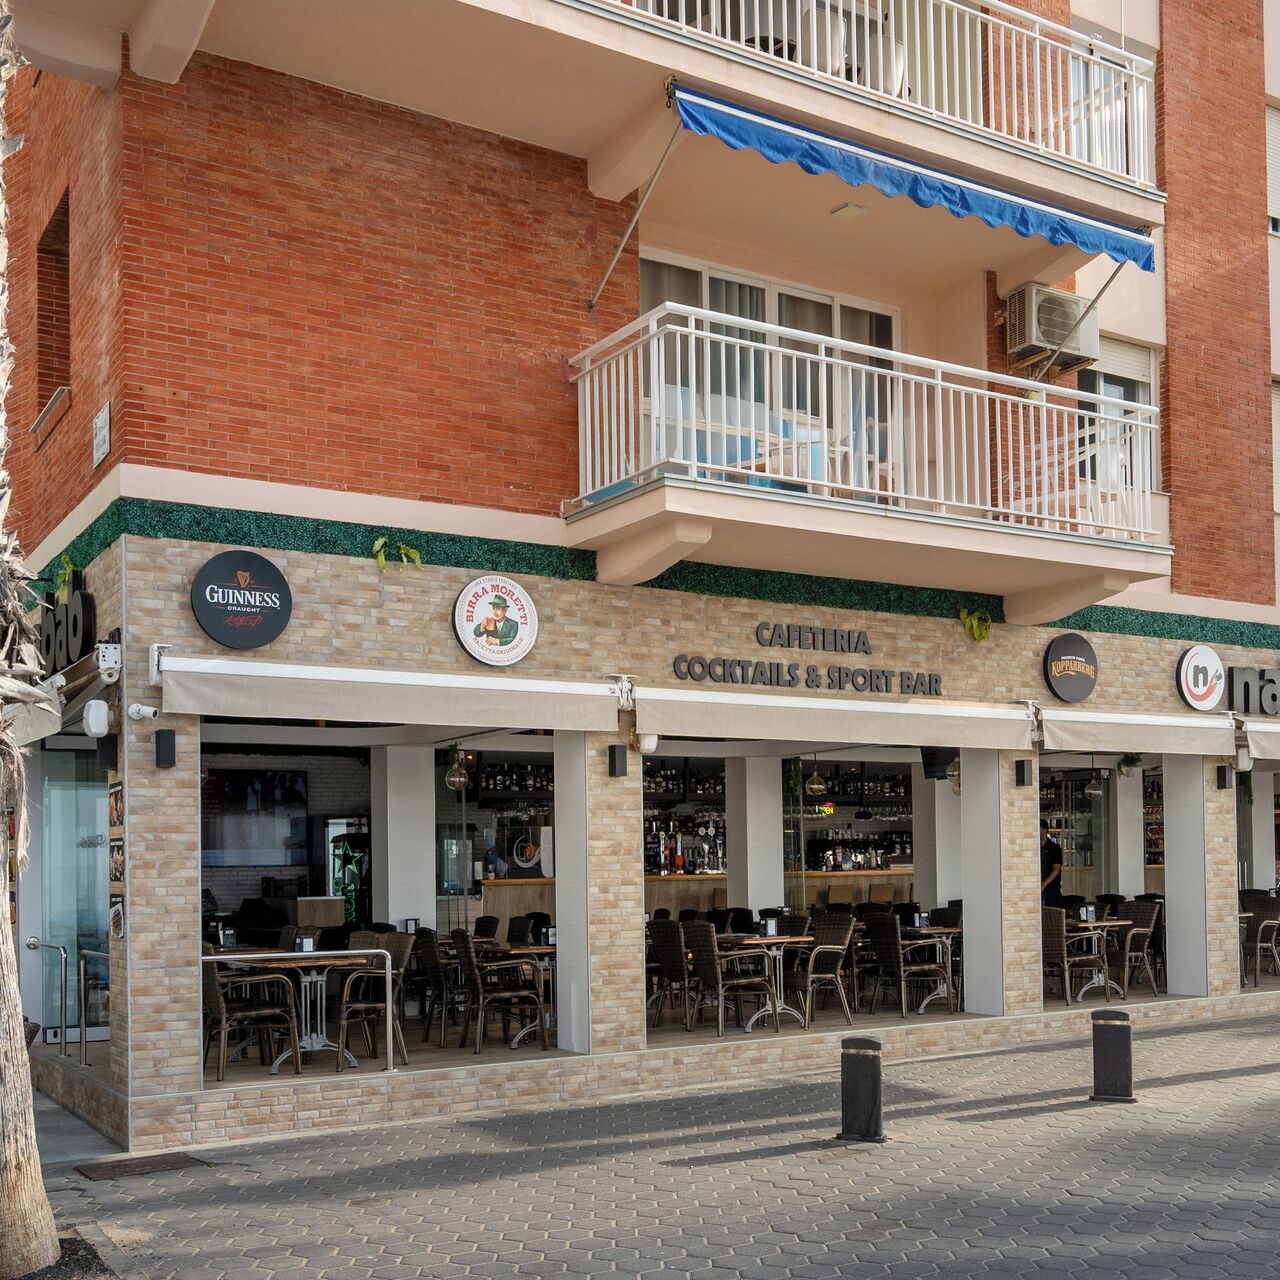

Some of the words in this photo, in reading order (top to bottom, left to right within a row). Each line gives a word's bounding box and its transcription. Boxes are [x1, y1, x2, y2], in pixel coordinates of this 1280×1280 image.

[205, 584, 280, 609] GUINNESS
[227, 605, 260, 613] DRAUGHT
[466, 586, 489, 623] BIRRA
[490, 584, 528, 625] MORETTI
[756, 622, 872, 655] CAFETERIA
[673, 654, 800, 688] COCKTAILS
[805, 664, 822, 689] &
[827, 665, 895, 694] SPORT
[900, 670, 943, 697] BAR
[1051, 660, 1094, 678] KOPPARBERG
